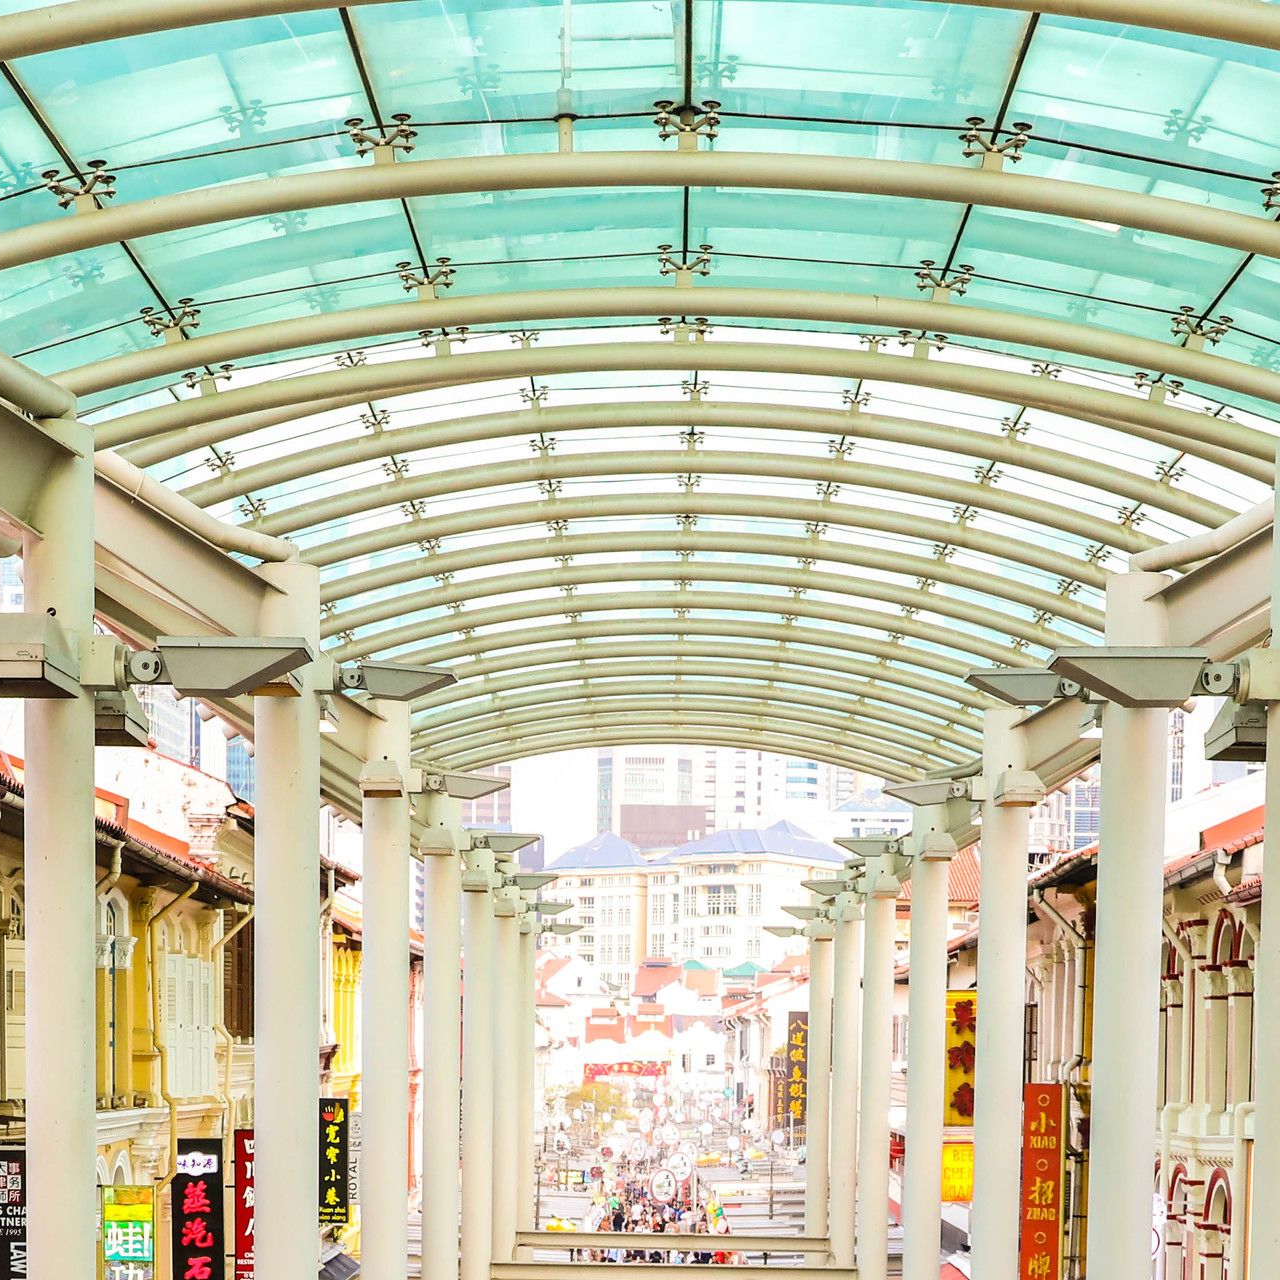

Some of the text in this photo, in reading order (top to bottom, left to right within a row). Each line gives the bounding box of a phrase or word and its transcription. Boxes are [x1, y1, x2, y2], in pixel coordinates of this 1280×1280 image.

[1030, 1112, 1057, 1134] 小
[1030, 1136, 1057, 1149] XIAO
[349, 1157, 358, 1200] ROYAL
[1028, 1176, 1055, 1206] 招
[6, 1205, 27, 1216] CHA
[1026, 1207, 1056, 1221] ZHAO
[10, 1241, 27, 1273] LAW
